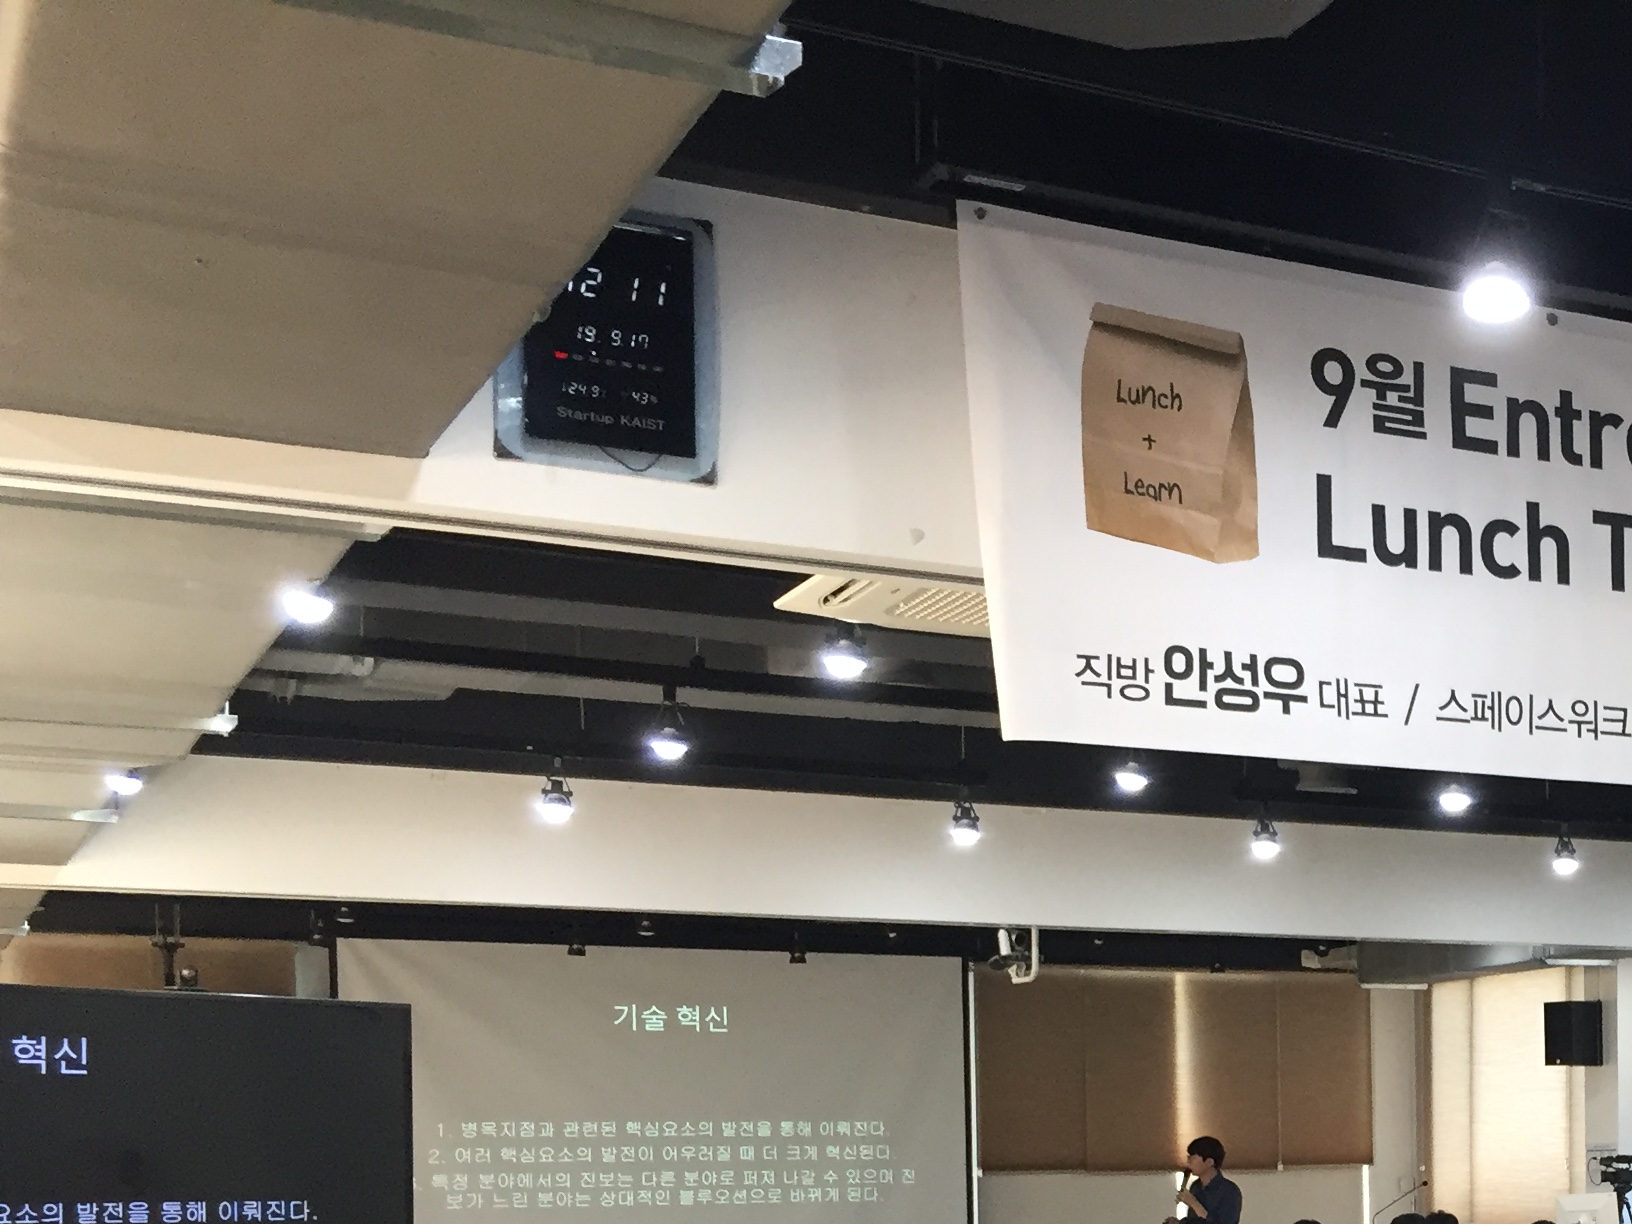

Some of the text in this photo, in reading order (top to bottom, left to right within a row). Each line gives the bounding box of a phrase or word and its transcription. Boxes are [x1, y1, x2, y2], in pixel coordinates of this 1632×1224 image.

[631, 277, 667, 306] 11
[1116, 379, 1183, 412] Lunch
[1311, 347, 1428, 440] 9월
[557, 406, 666, 430] Startup KAIST
[1123, 472, 1183, 505] Learn
[1316, 473, 1570, 585] Lunch
[1075, 653, 1155, 703] 직방
[1163, 644, 1308, 715] 안성우
[1318, 677, 1389, 721] 대표
[1436, 690, 1632, 741] 스페이스워크
[613, 1004, 729, 1033] 기술 혁신
[12, 1034, 89, 1075] 혁신
[563, 1121, 617, 1138] 관련된
[626, 1120, 714, 1137] 핵심요소의
[722, 1120, 772, 1137] 발전을
[780, 1121, 812, 1137] 통해
[455, 1147, 491, 1164] 여러
[501, 1147, 592, 1163] 핵심요소의
[601, 1146, 653, 1163] 발전이
[663, 1145, 732, 1162] 어우러질
[740, 1145, 754, 1161] 때
[763, 1145, 777, 1161] 더
[786, 1145, 818, 1160] 크게
[432, 1173, 468, 1190] 특정
[479, 1172, 571, 1189] 분야에서의
[580, 1172, 633, 1188] 진보는
[641, 1171, 676, 1187] 다른
[684, 1170, 735, 1186] 분야로
[743, 1170, 775, 1185] 퍼져
[783, 1169, 815, 1185] 나갈
[824, 1169, 838, 1184] 수
[847, 1168, 894, 1184] 있으며
[901, 1168, 915, 1184] 진
[77, 1201, 150, 1224] 발전을
[161, 1201, 207, 1224] 통해
[218, 1200, 318, 1222] 이뤄진다.
[446, 1193, 483, 1209] 보가
[493, 1192, 528, 1208] 느린
[538, 1191, 591, 1207] 분야는
[600, 1190, 671, 1206] 상대적인
[790, 1187, 839, 1203] 바뀌게
